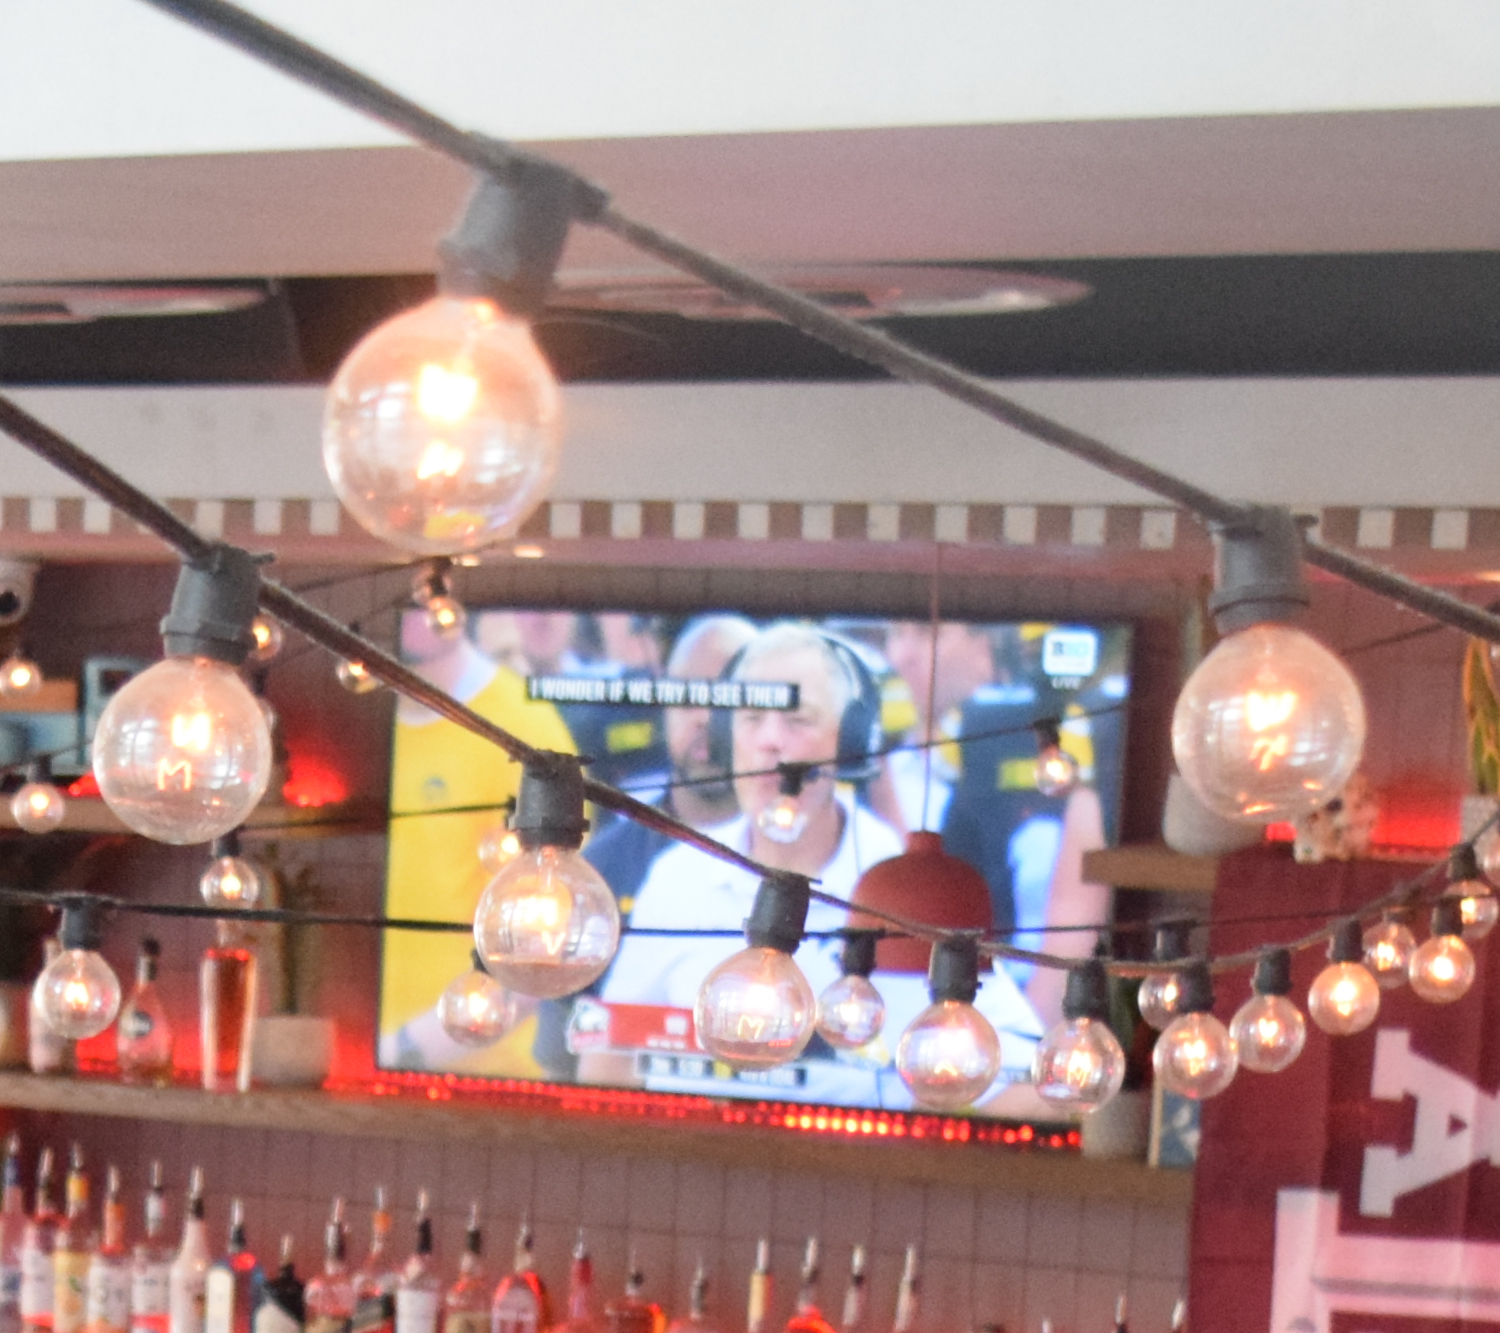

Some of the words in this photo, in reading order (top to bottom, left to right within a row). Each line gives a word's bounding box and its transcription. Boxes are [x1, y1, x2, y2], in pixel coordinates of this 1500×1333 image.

[531, 679, 538, 698] I
[542, 679, 605, 701] WONDER
[610, 681, 625, 701] IF
[628, 681, 653, 702] WE
[655, 683, 686, 703] TRY
[688, 684, 709, 704] TO
[711, 684, 741, 706] SEE
[745, 685, 789, 707] THEM
